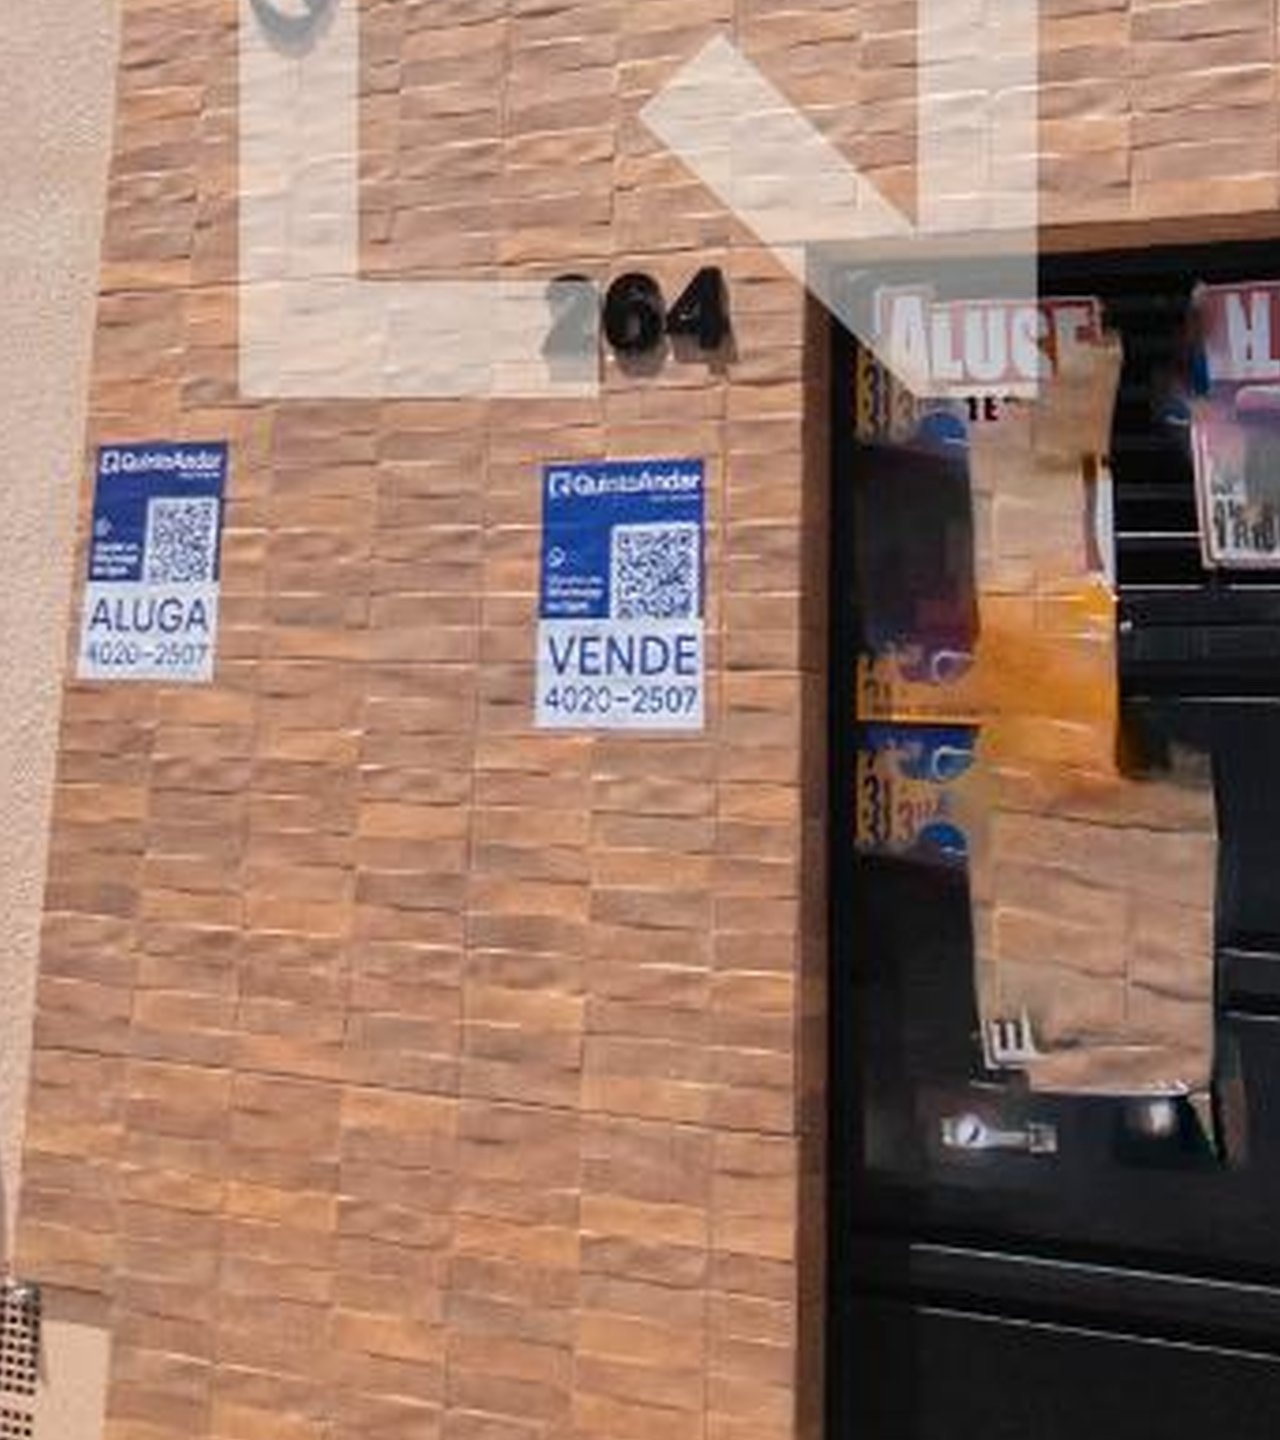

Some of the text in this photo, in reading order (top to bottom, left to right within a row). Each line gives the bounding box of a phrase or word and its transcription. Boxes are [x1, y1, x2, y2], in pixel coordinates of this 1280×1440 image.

[88, 597, 209, 633] ALUGA
[548, 634, 697, 676] VENDE
[544, 684, 698, 713] 4020-2507
